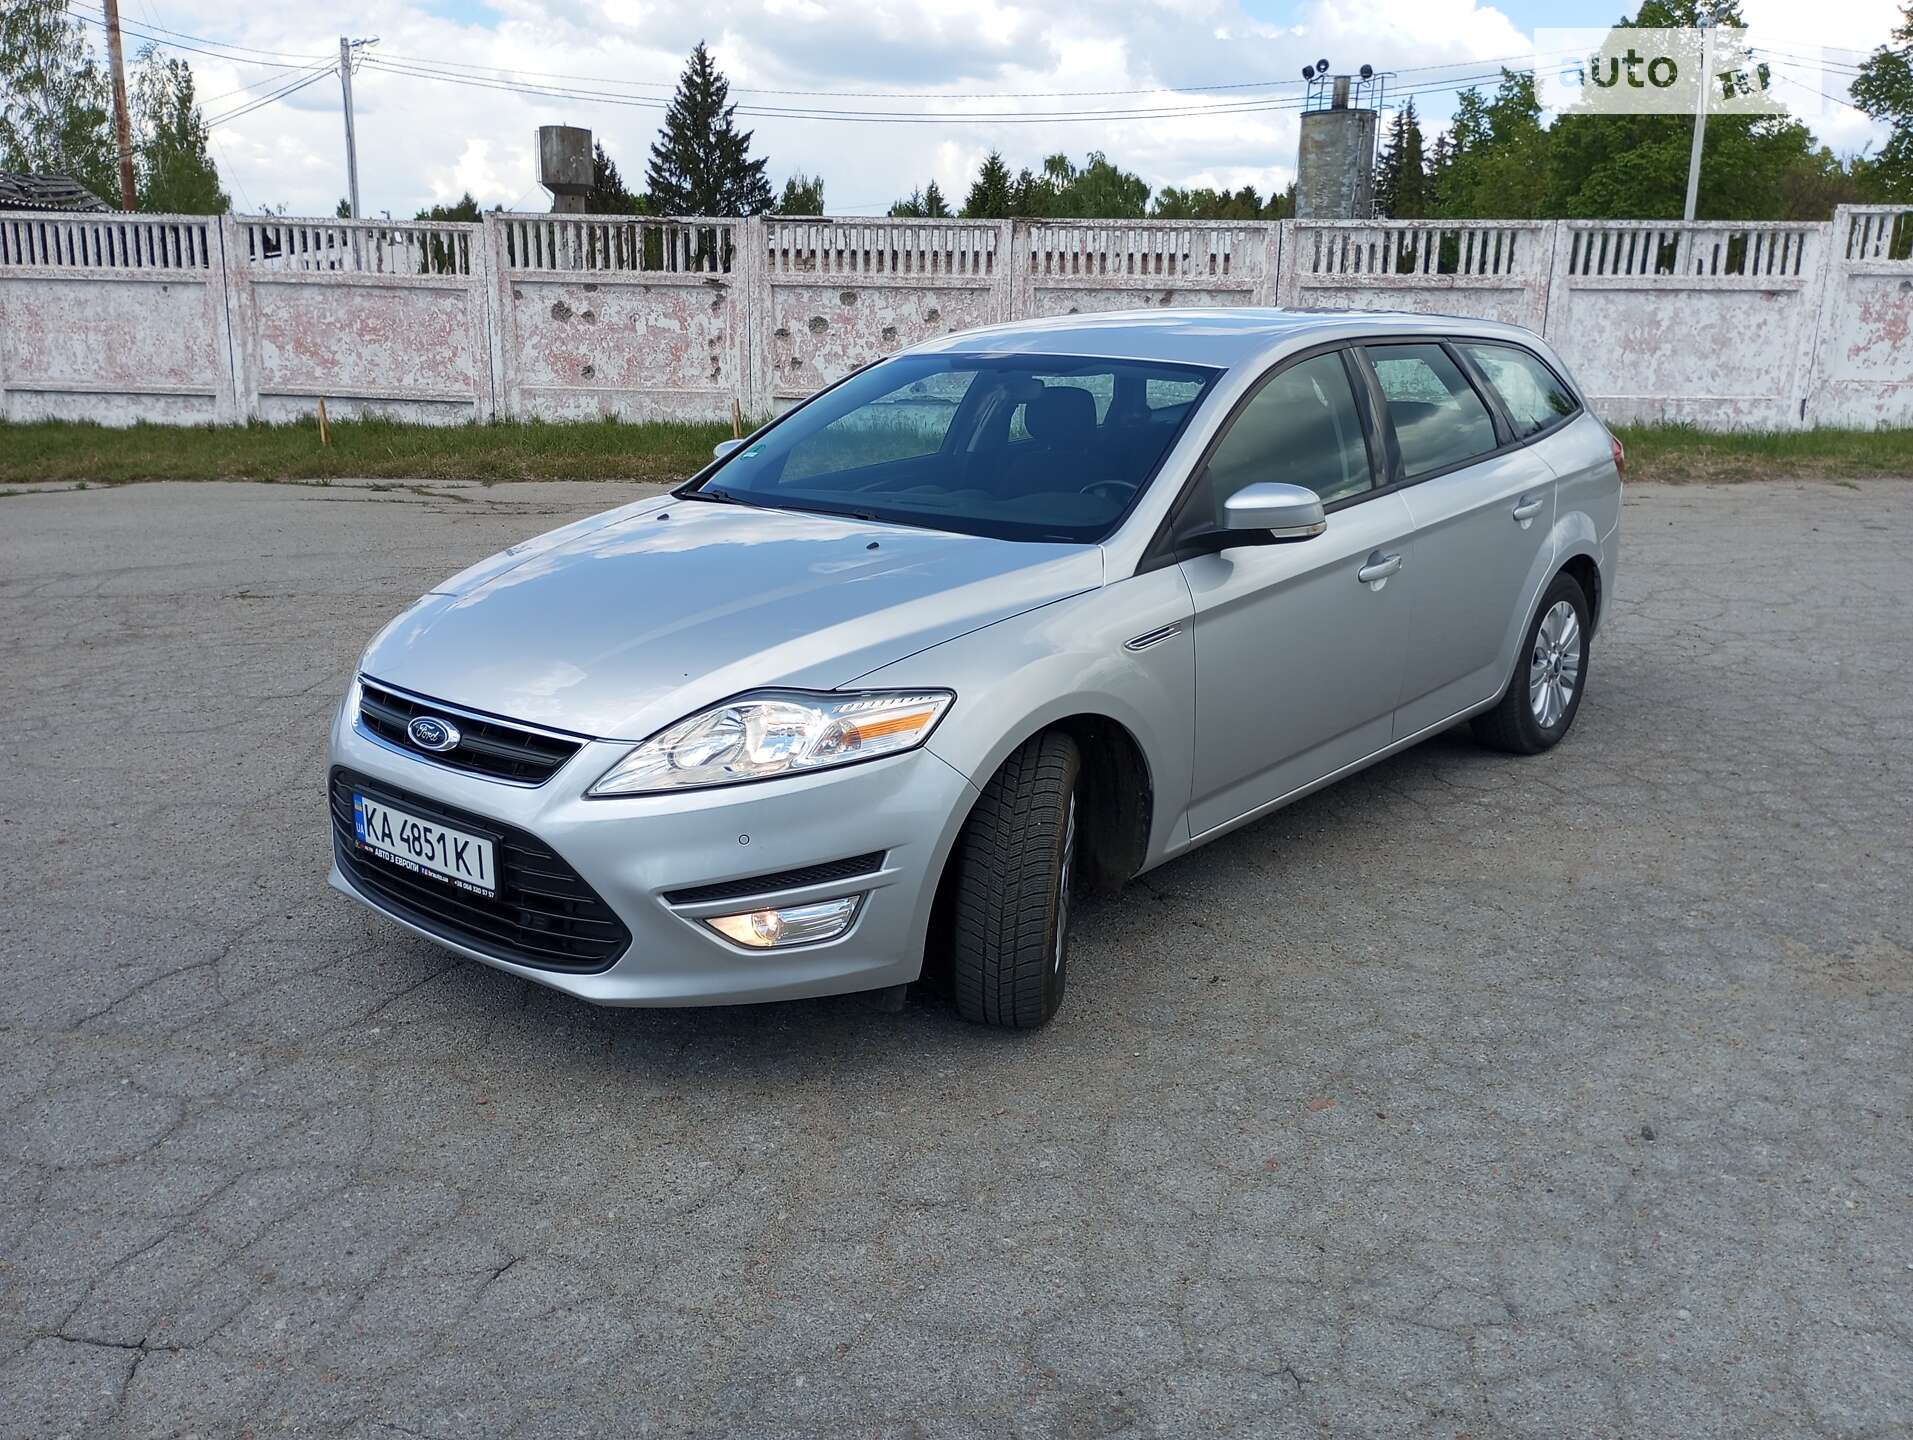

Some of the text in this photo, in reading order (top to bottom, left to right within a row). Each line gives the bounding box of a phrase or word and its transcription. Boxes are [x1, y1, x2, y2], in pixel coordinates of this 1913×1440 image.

[417, 723, 440, 742] Ford
[356, 822, 365, 835] UA
[364, 804, 484, 880] KA 4851 KI
[375, 848, 390, 861] АВТО
